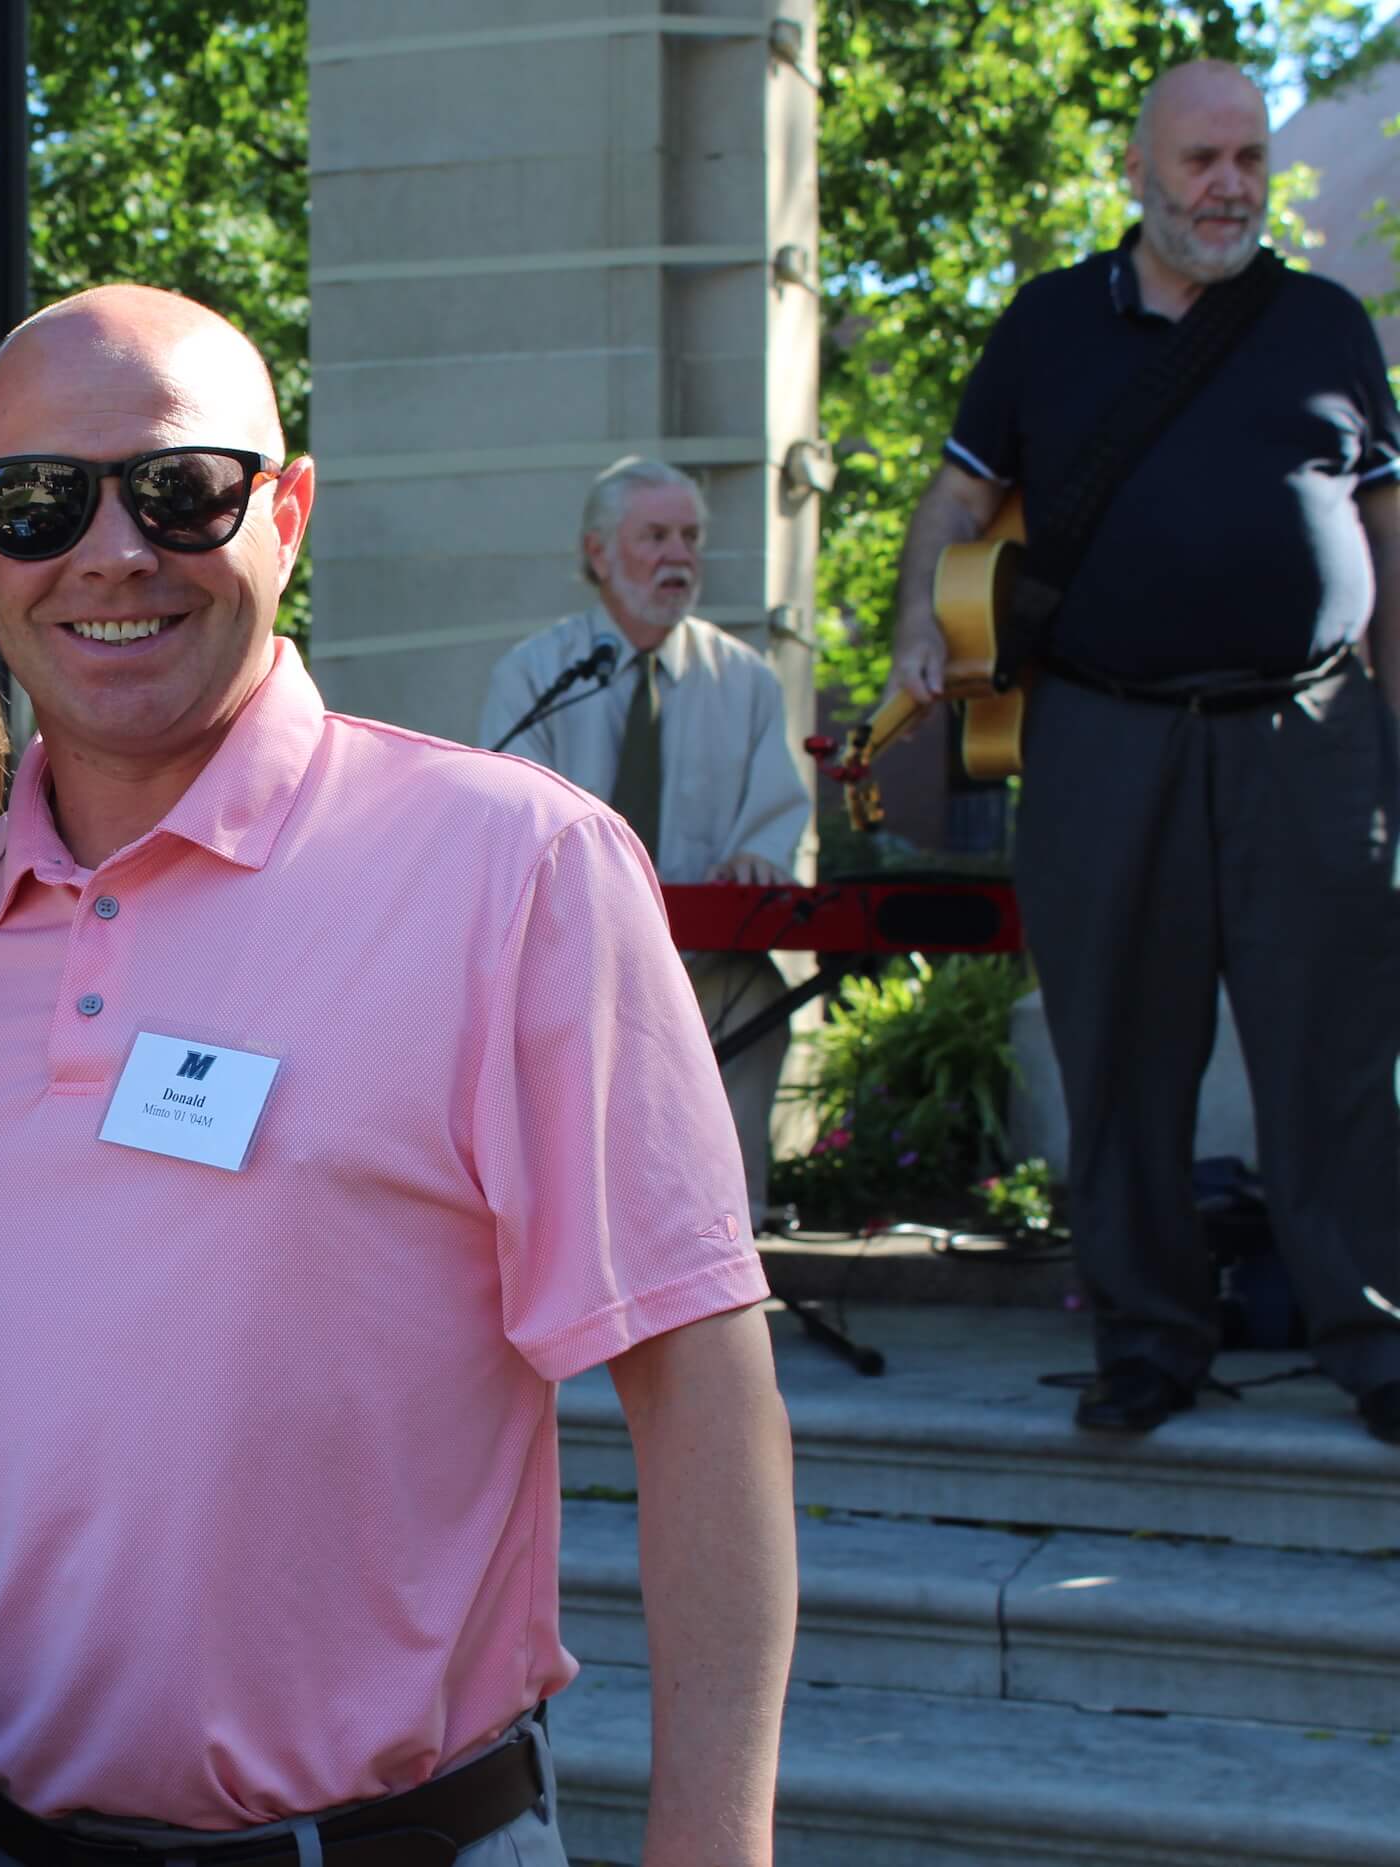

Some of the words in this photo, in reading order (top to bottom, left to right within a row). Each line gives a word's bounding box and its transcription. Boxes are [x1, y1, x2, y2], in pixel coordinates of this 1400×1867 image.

[176, 1050, 217, 1081] M
[162, 1087, 206, 1108] Donald
[143, 1103, 170, 1118] Minto
